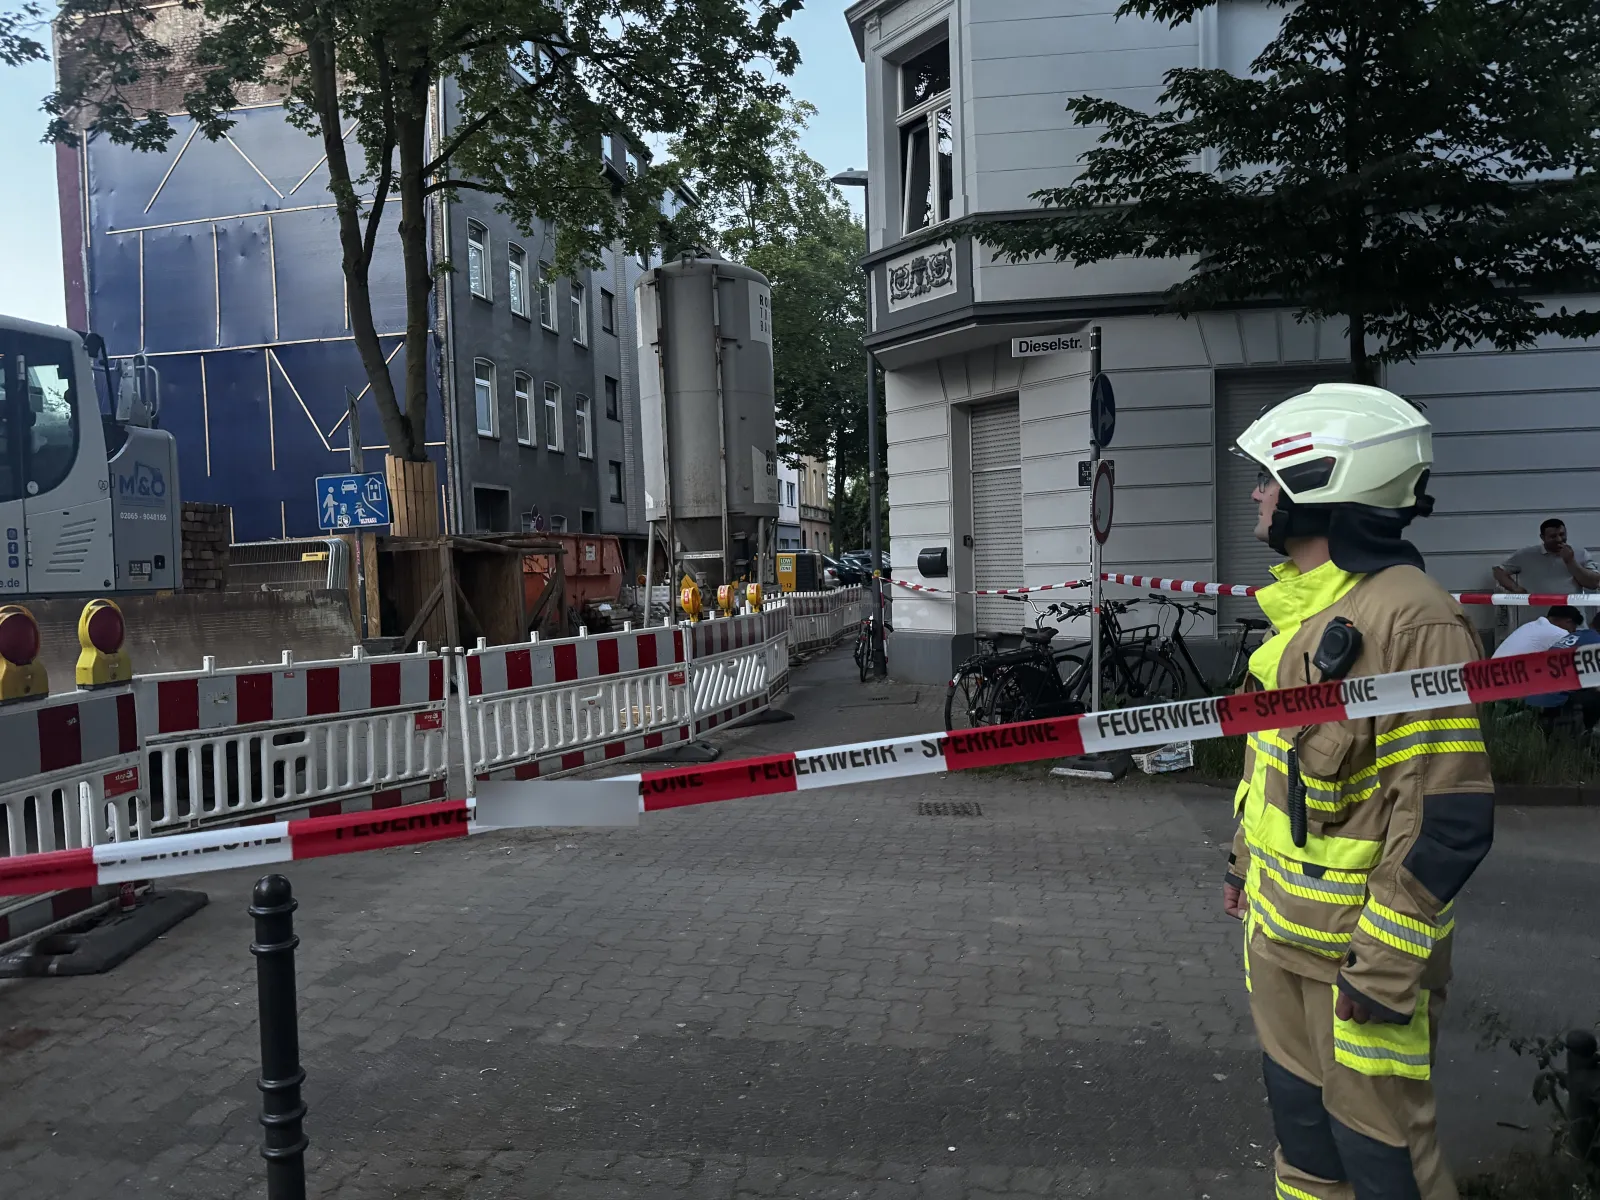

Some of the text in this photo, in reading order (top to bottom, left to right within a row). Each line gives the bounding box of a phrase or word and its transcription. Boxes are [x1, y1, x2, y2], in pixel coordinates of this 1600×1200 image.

[1019, 338, 1082, 352] Dieselstr.
[119, 473, 166, 497] M&O
[1410, 660, 1530, 698] FEUERWEHR
[1097, 697, 1233, 738] FEUERWEHR
[1254, 677, 1378, 717] SPERRZONE
[748, 745, 897, 782] FEUERWEHR
[921, 722, 1059, 758] SPERRZONE
